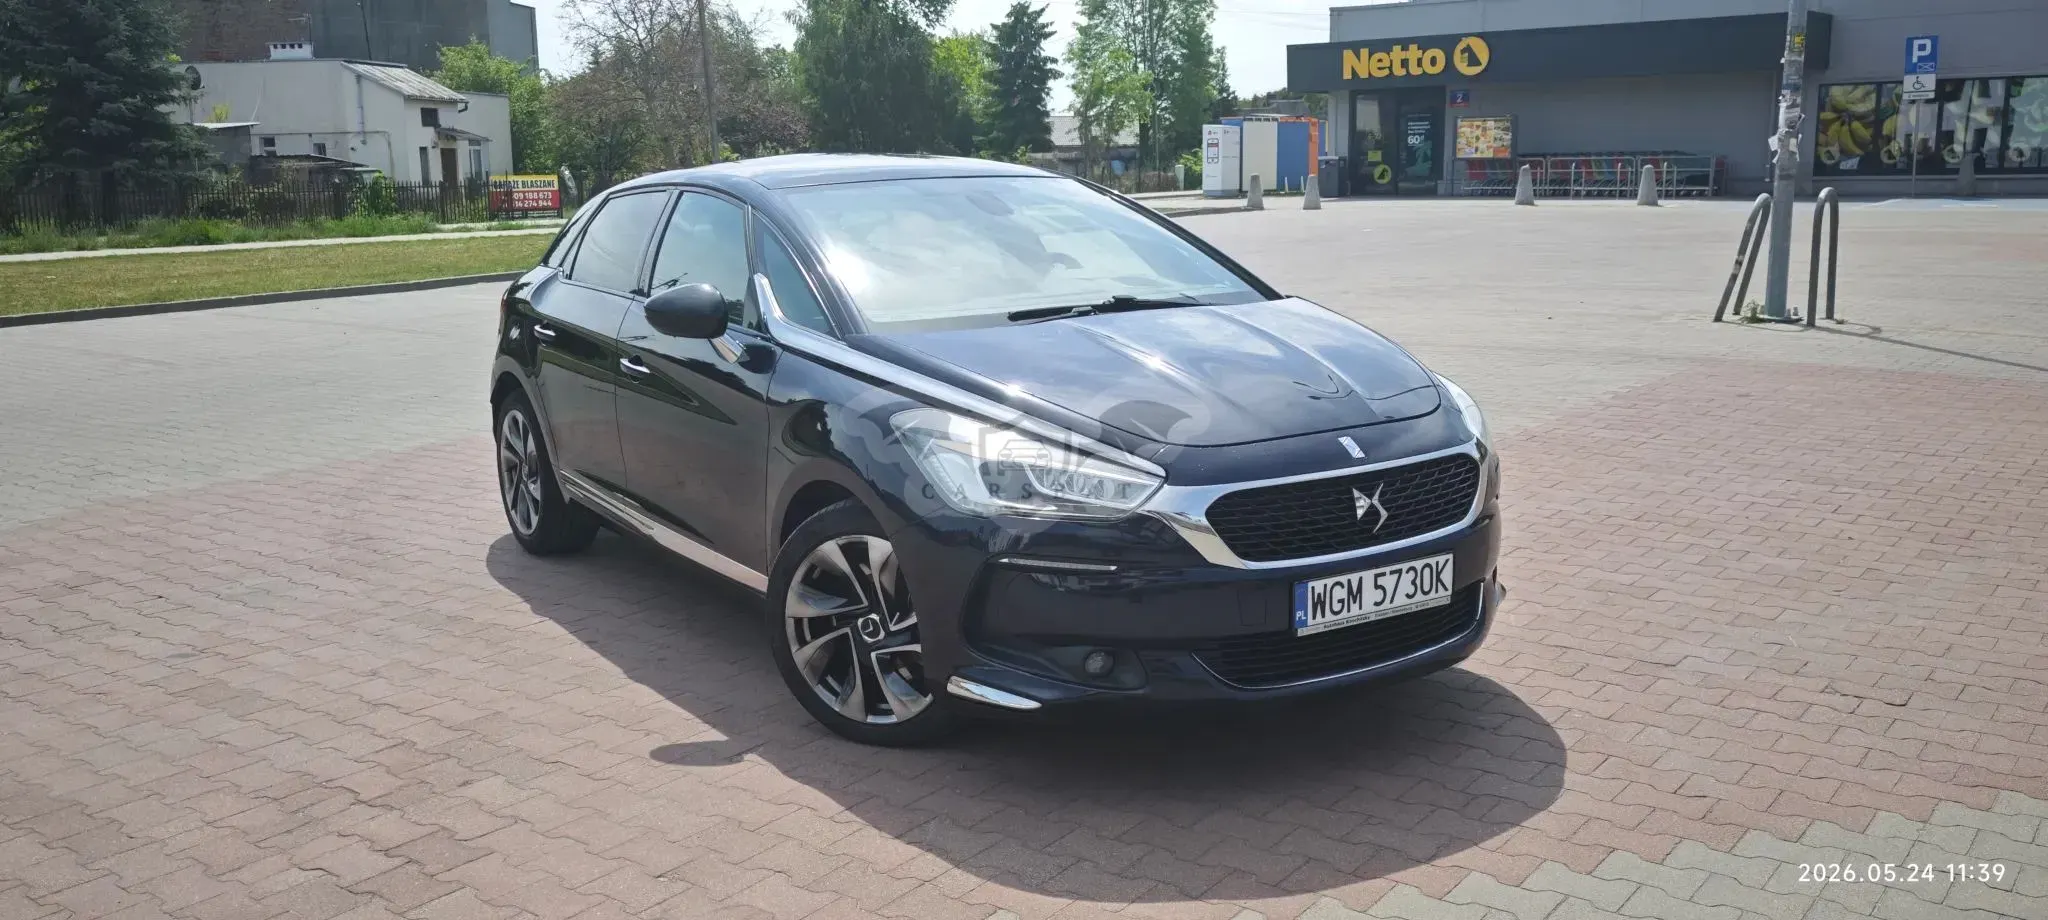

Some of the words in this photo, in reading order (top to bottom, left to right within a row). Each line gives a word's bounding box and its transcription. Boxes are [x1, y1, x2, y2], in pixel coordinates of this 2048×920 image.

[1912, 38, 1932, 63] P
[1342, 44, 1446, 80] Netto
[1456, 94, 1464, 103] 2
[521, 180, 555, 189] BLASZANE
[539, 191, 552, 199] 673
[524, 199, 537, 207] 274
[538, 199, 552, 207] 944
[1310, 575, 1363, 621] WGM
[1373, 558, 1450, 607] 5730K
[1295, 609, 1307, 621] PL
